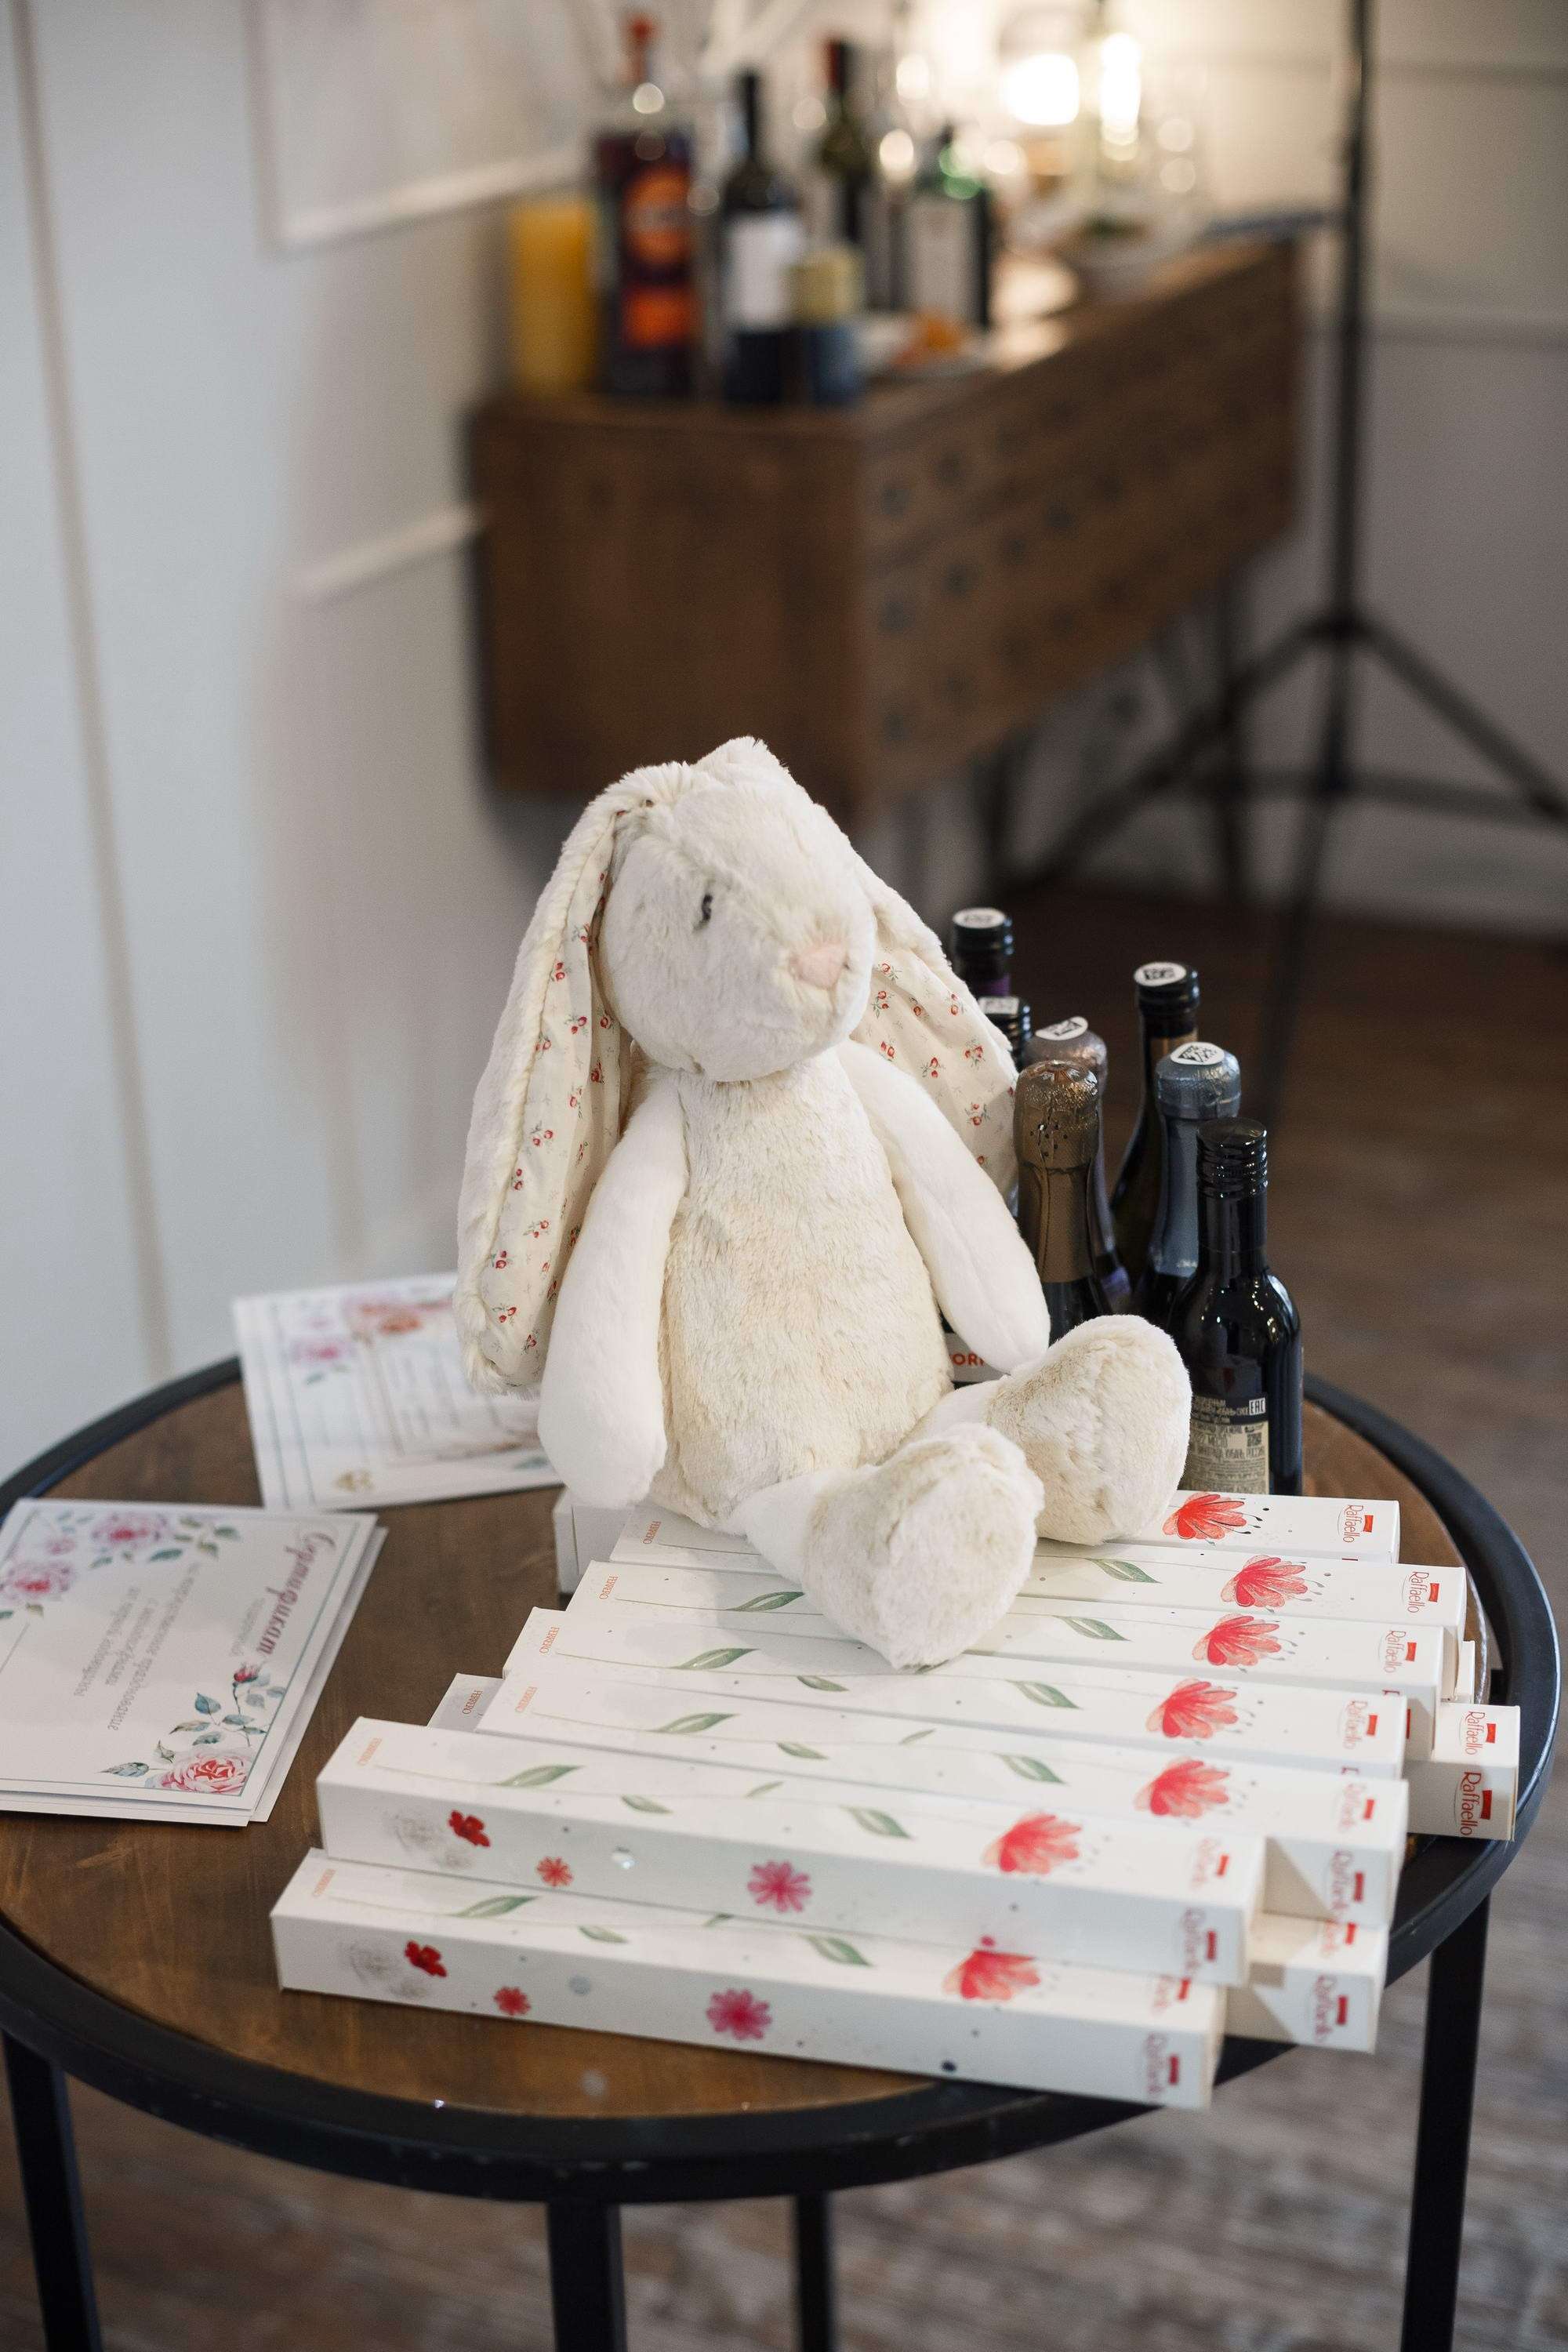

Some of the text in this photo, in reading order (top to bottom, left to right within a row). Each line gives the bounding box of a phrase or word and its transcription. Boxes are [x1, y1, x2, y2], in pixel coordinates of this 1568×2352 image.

[1249, 1398, 1265, 1414] EAC
[1342, 1504, 1364, 1543] Raffaello
[599, 1576, 619, 1599] FERRERO
[1407, 1570, 1429, 1613] Raffaello
[539, 1626, 560, 1653] FERRERO
[1383, 1630, 1406, 1674] Raffaello
[462, 1690, 483, 1715] FERRERO
[1464, 1711, 1486, 1755] Raffaello
[1459, 1771, 1482, 1836] Raffaello
